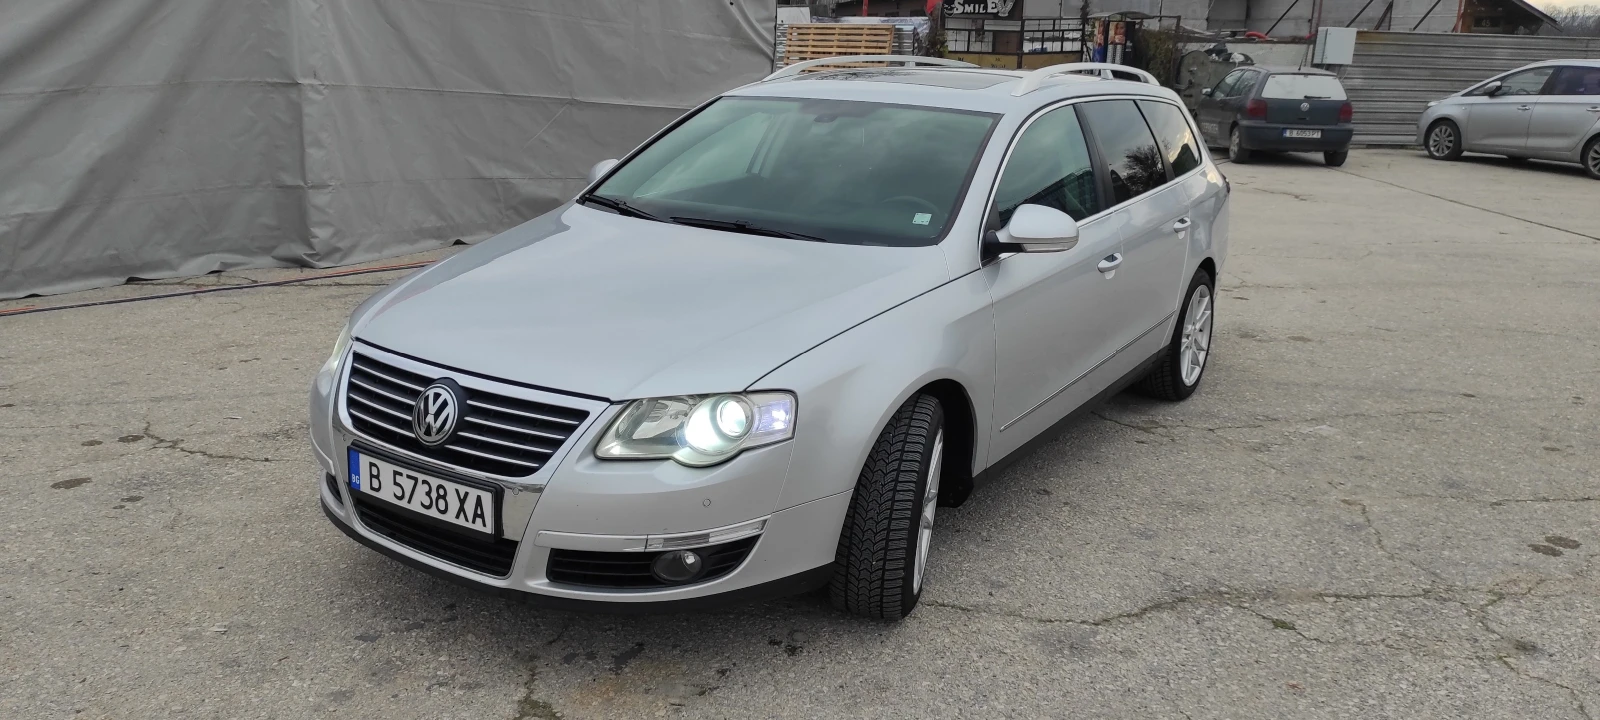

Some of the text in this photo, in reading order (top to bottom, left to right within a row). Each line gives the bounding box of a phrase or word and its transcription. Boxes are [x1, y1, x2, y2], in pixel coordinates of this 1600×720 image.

[351, 473, 360, 485] BG
[368, 461, 487, 528] B 5738 XA
